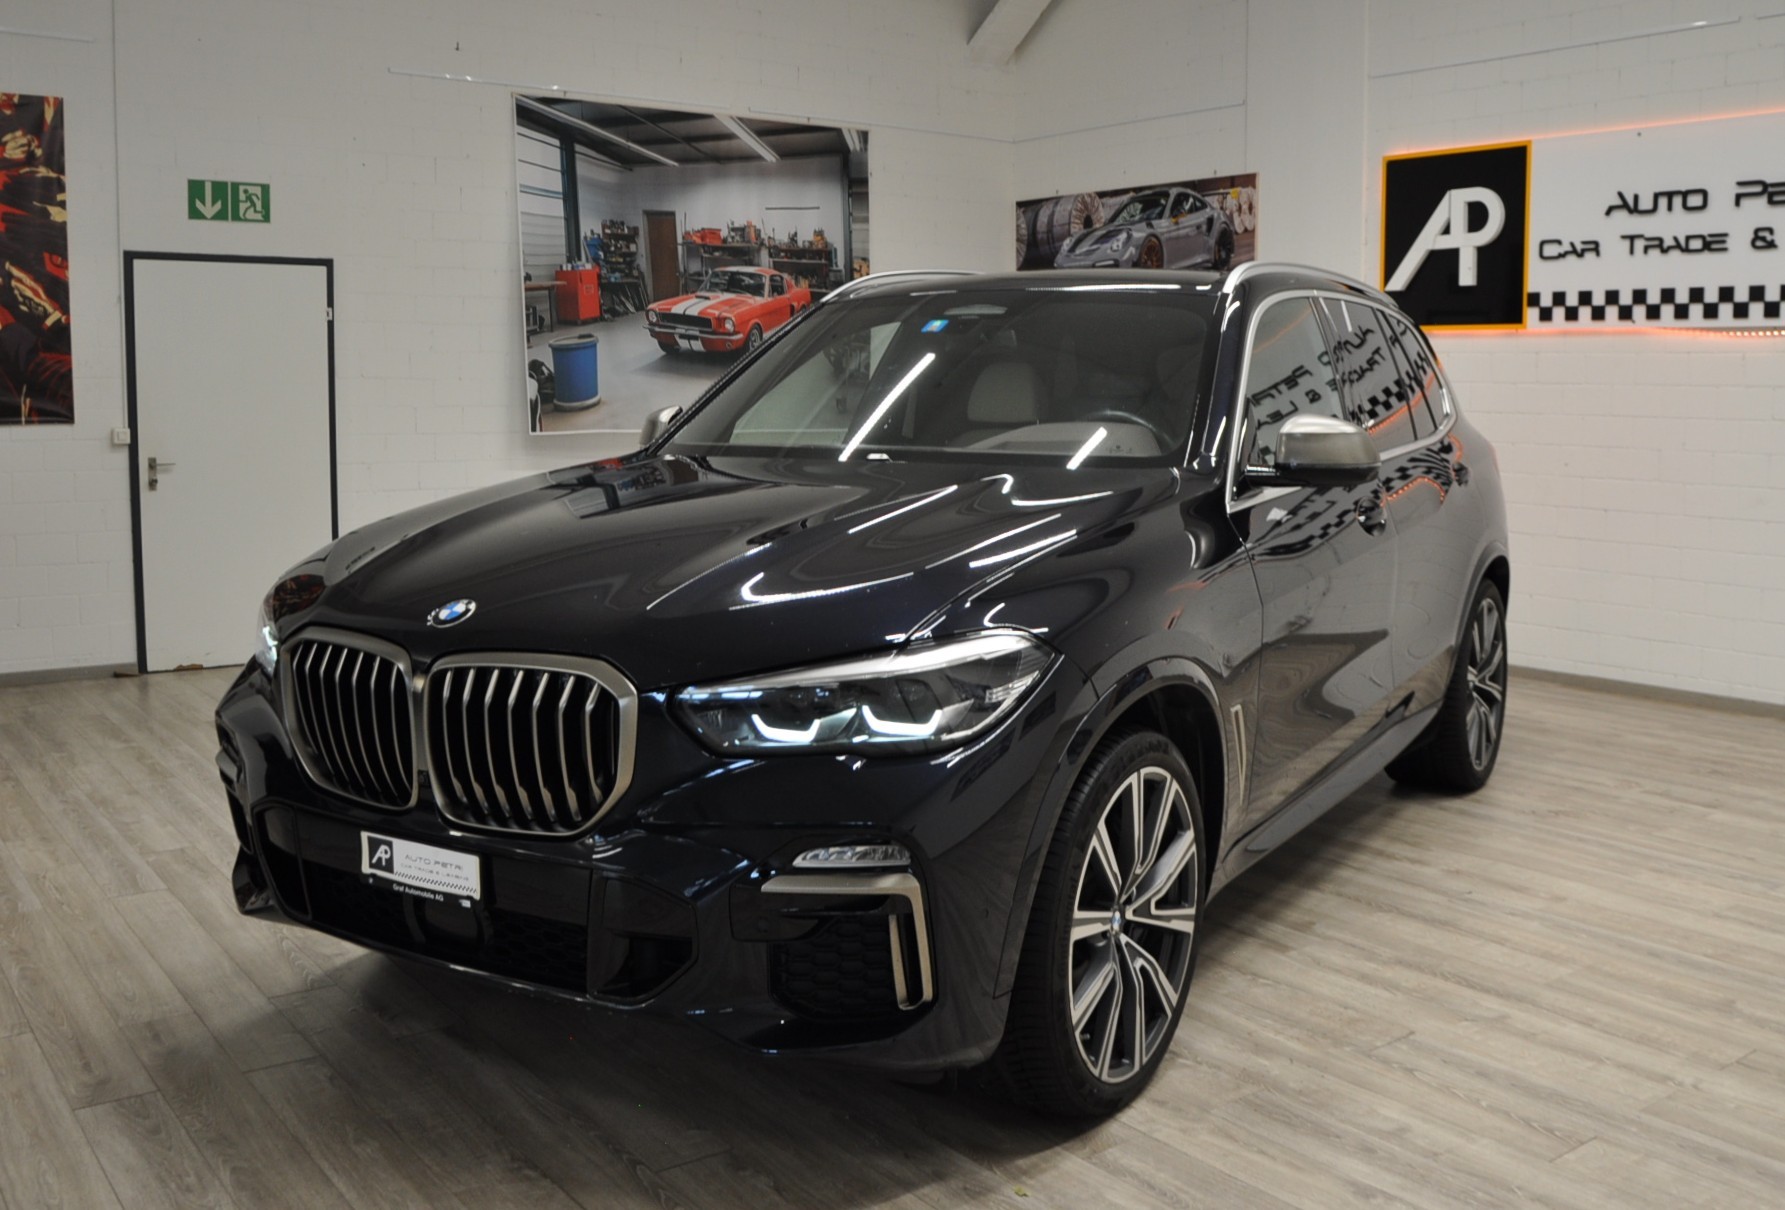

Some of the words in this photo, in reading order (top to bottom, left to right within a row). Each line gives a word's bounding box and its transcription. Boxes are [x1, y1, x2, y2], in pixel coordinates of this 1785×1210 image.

[1605, 188, 1709, 217] AUTO
[1539, 239, 1600, 261] CAR
[1620, 232, 1729, 256] TRADE
[1750, 227, 1778, 250] &
[405, 854, 432, 866] AUTO
